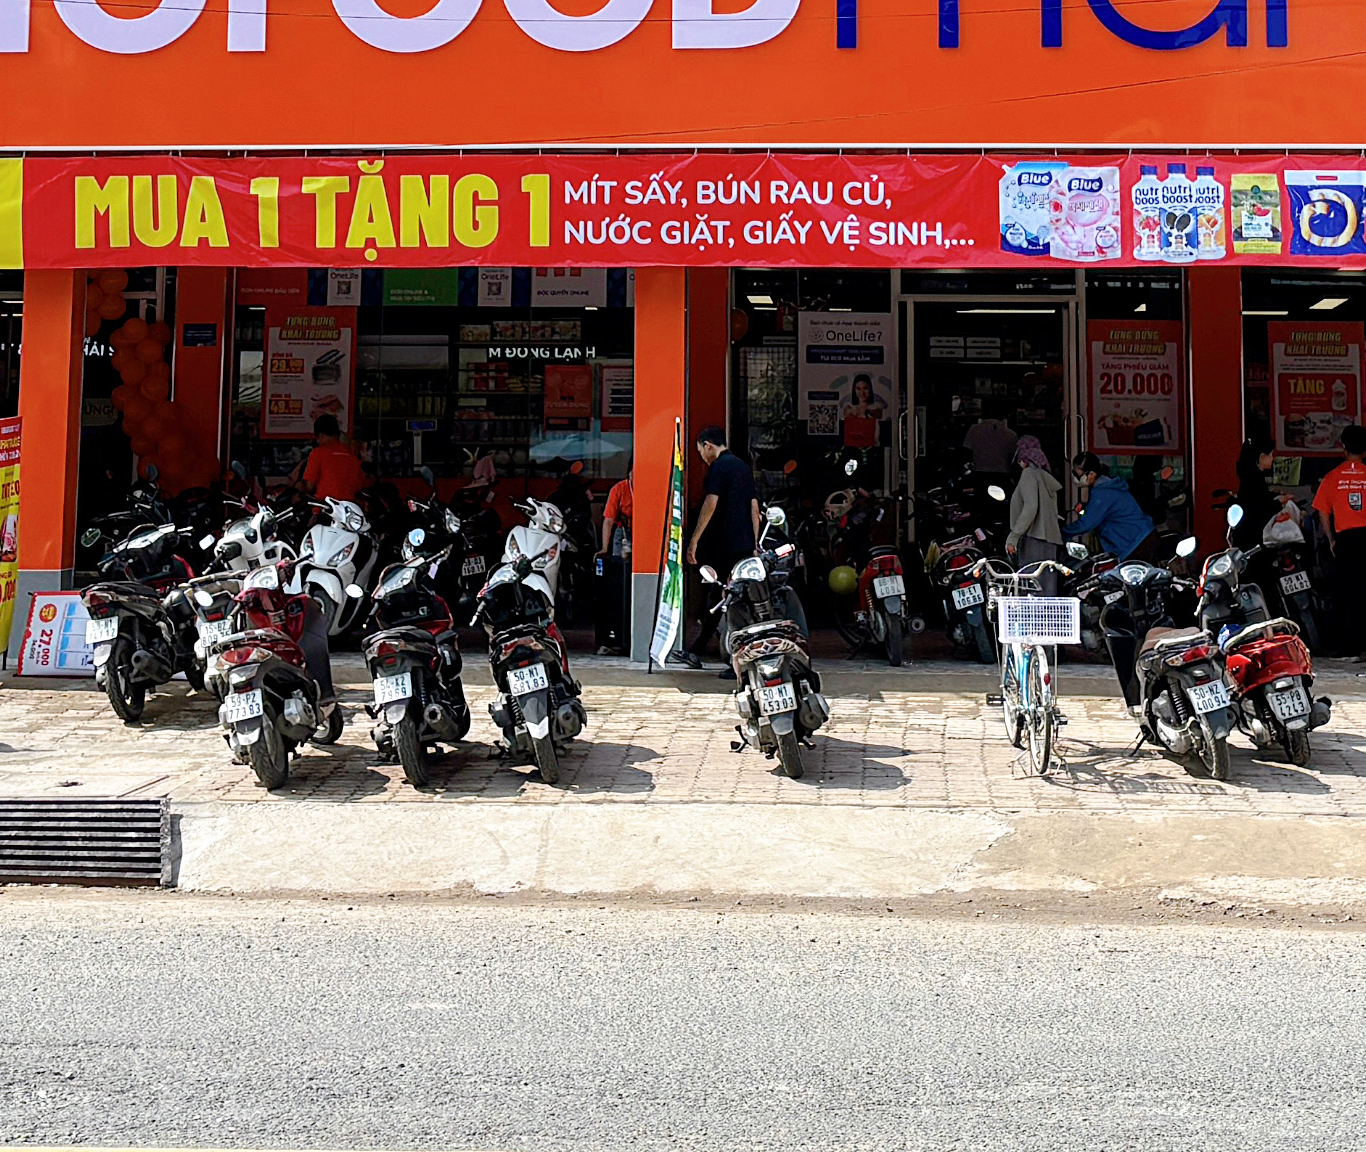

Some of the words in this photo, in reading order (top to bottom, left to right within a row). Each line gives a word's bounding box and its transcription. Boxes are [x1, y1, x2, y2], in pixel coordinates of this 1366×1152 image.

[1020, 173, 1050, 185] Blue
[1070, 179, 1100, 191] Blue
[564, 174, 618, 205] MÍT
[624, 170, 688, 209] SẤY,
[696, 173, 762, 205] BÚN
[769, 181, 835, 205] RAU
[842, 174, 893, 210] CỦ,
[1135, 187, 1160, 196] nutr
[1135, 196, 1160, 205] boos
[1161, 194, 1193, 204] boost
[74, 175, 230, 248] MUA
[250, 176, 280, 248] 1
[301, 159, 500, 261] TẶNG
[521, 173, 551, 248] 1
[564, 214, 652, 245] NƯỚC
[660, 213, 734, 251] GIẶT,
[742, 209, 814, 245] GIẤY
[819, 215, 861, 251] VỆ
[825, 329, 882, 343] OneLife?
